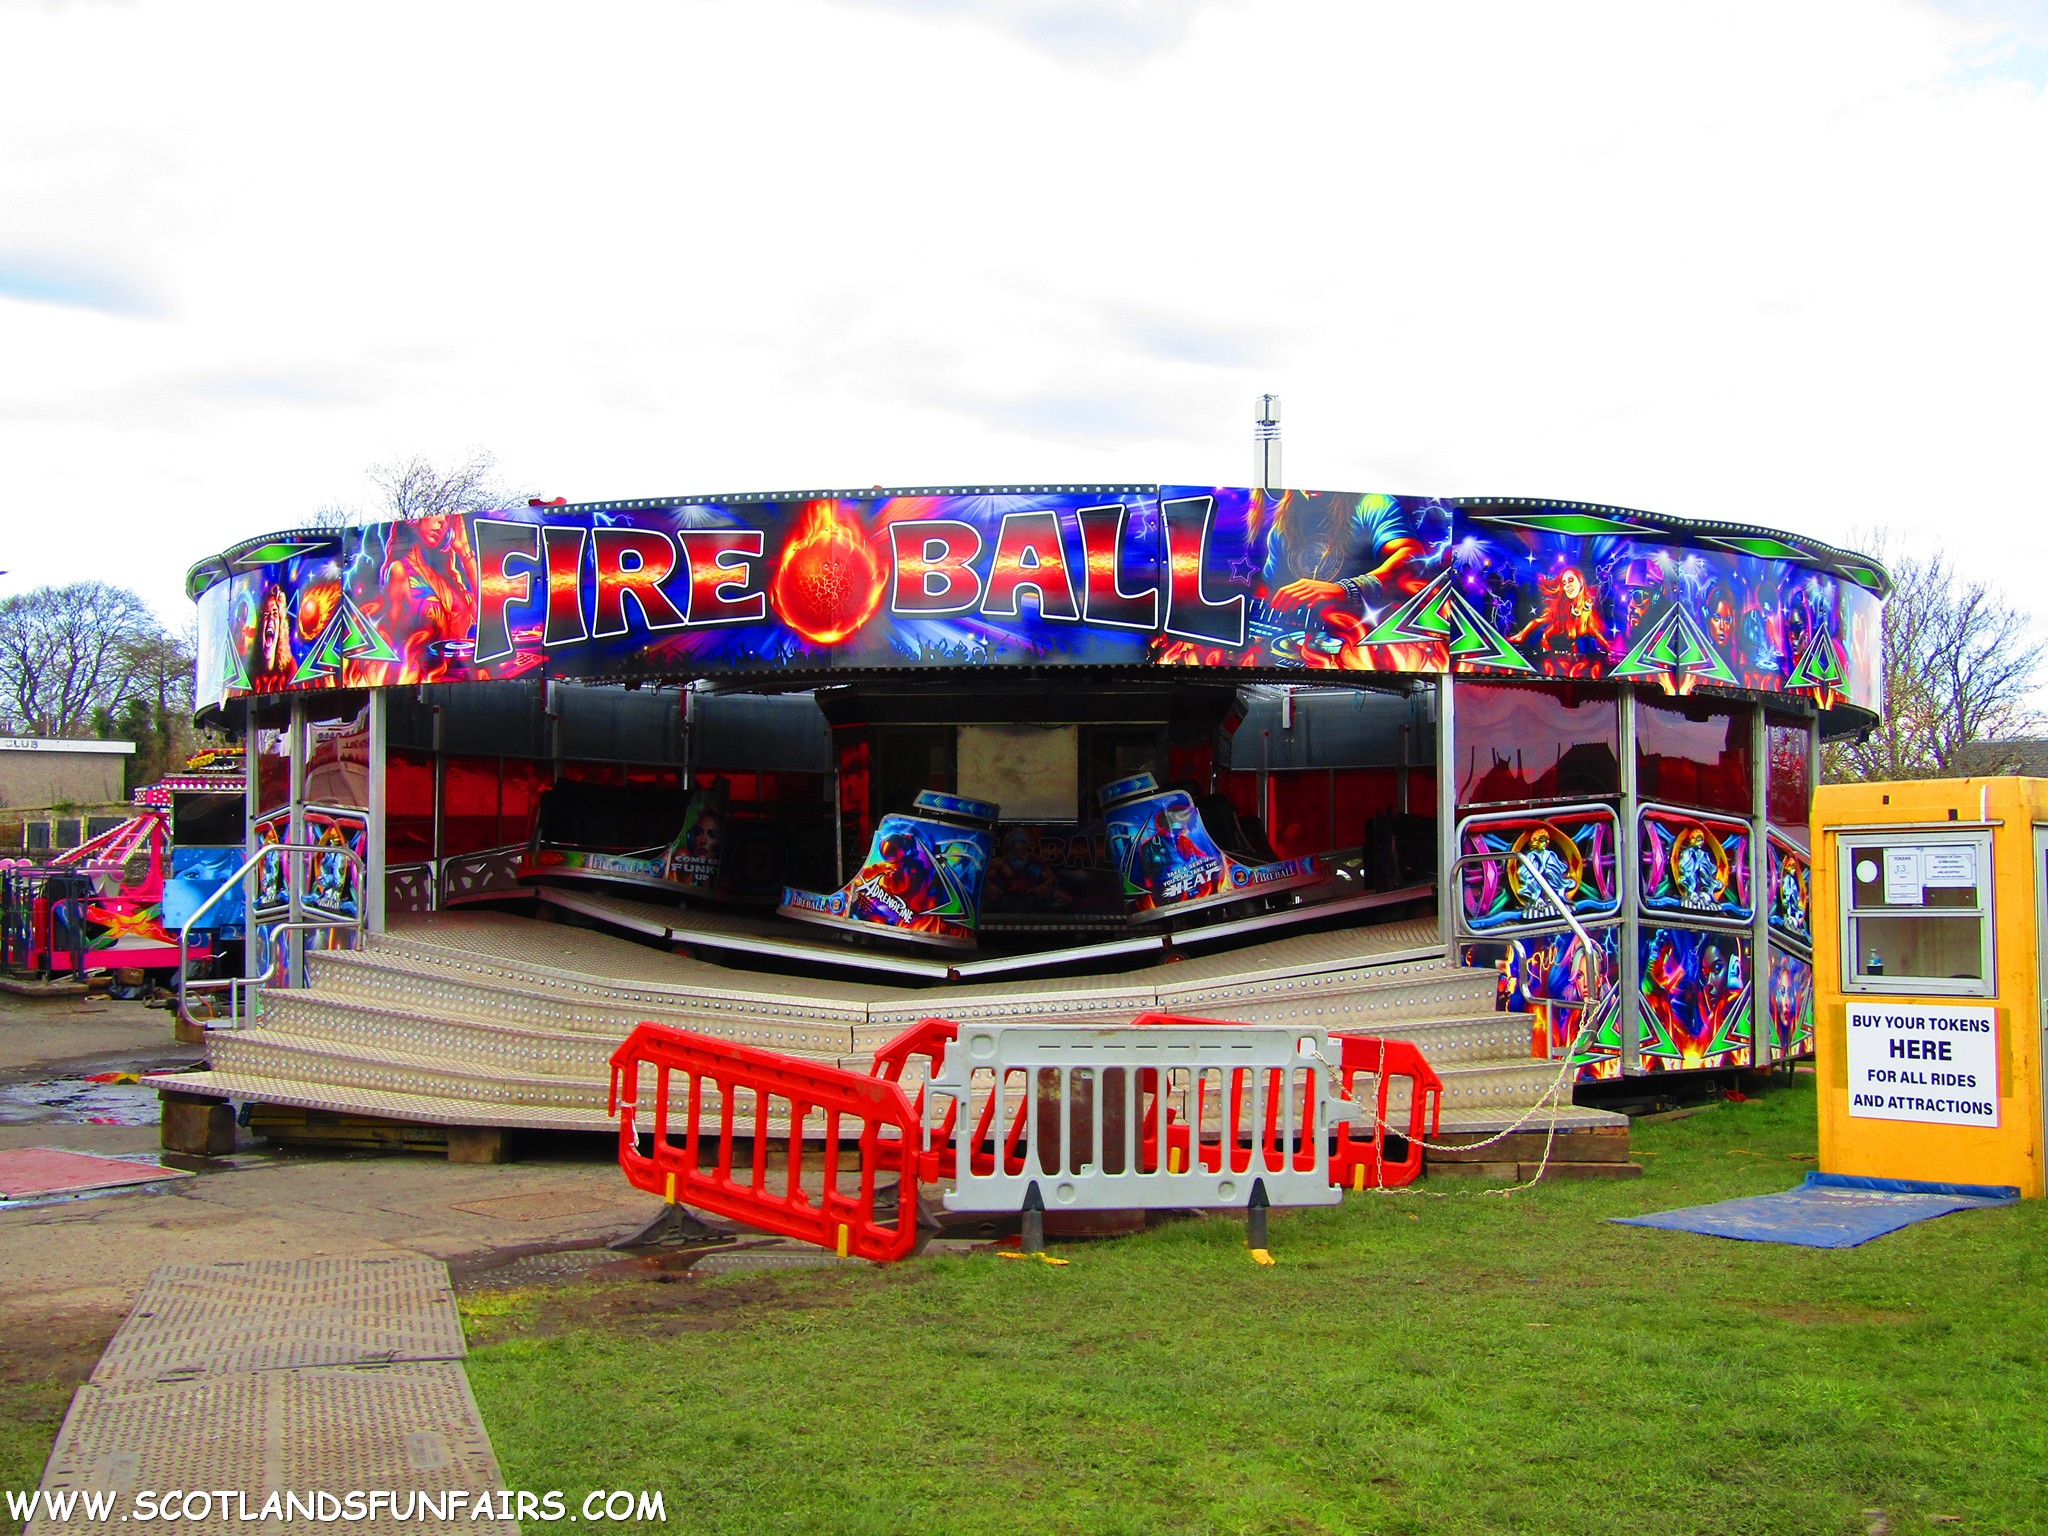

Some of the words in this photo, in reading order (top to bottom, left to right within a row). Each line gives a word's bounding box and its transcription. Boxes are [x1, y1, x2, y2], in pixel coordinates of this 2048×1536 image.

[474, 518, 766, 663] FIRE
[888, 494, 1245, 647] BALL
[5, 739, 39, 749] CLUB
[1161, 865, 1223, 898] HEAT
[1163, 879, 1175, 887] YOU
[1176, 873, 1189, 881] CAN
[1190, 866, 1204, 875] TAKE
[1205, 861, 1217, 869] THE
[1167, 869, 1181, 878] TAKE
[1236, 871, 1246, 883] 2
[1253, 864, 1296, 884] FIREBALL
[793, 894, 827, 911] FIREBALL
[855, 874, 914, 924] ADRENALINE
[1852, 1015, 1881, 1028] BUY
[1885, 1016, 1925, 1030] YOUR
[1928, 1018, 1990, 1032] TOKENS
[1889, 1038, 1952, 1061] HERE
[1867, 1069, 1896, 1083] FOR
[1900, 1071, 1927, 1085] ALL
[1931, 1073, 1976, 1088] RIDES
[1853, 1094, 1884, 1107] AND
[1888, 1096, 1993, 1115] ATTRACTIONS
